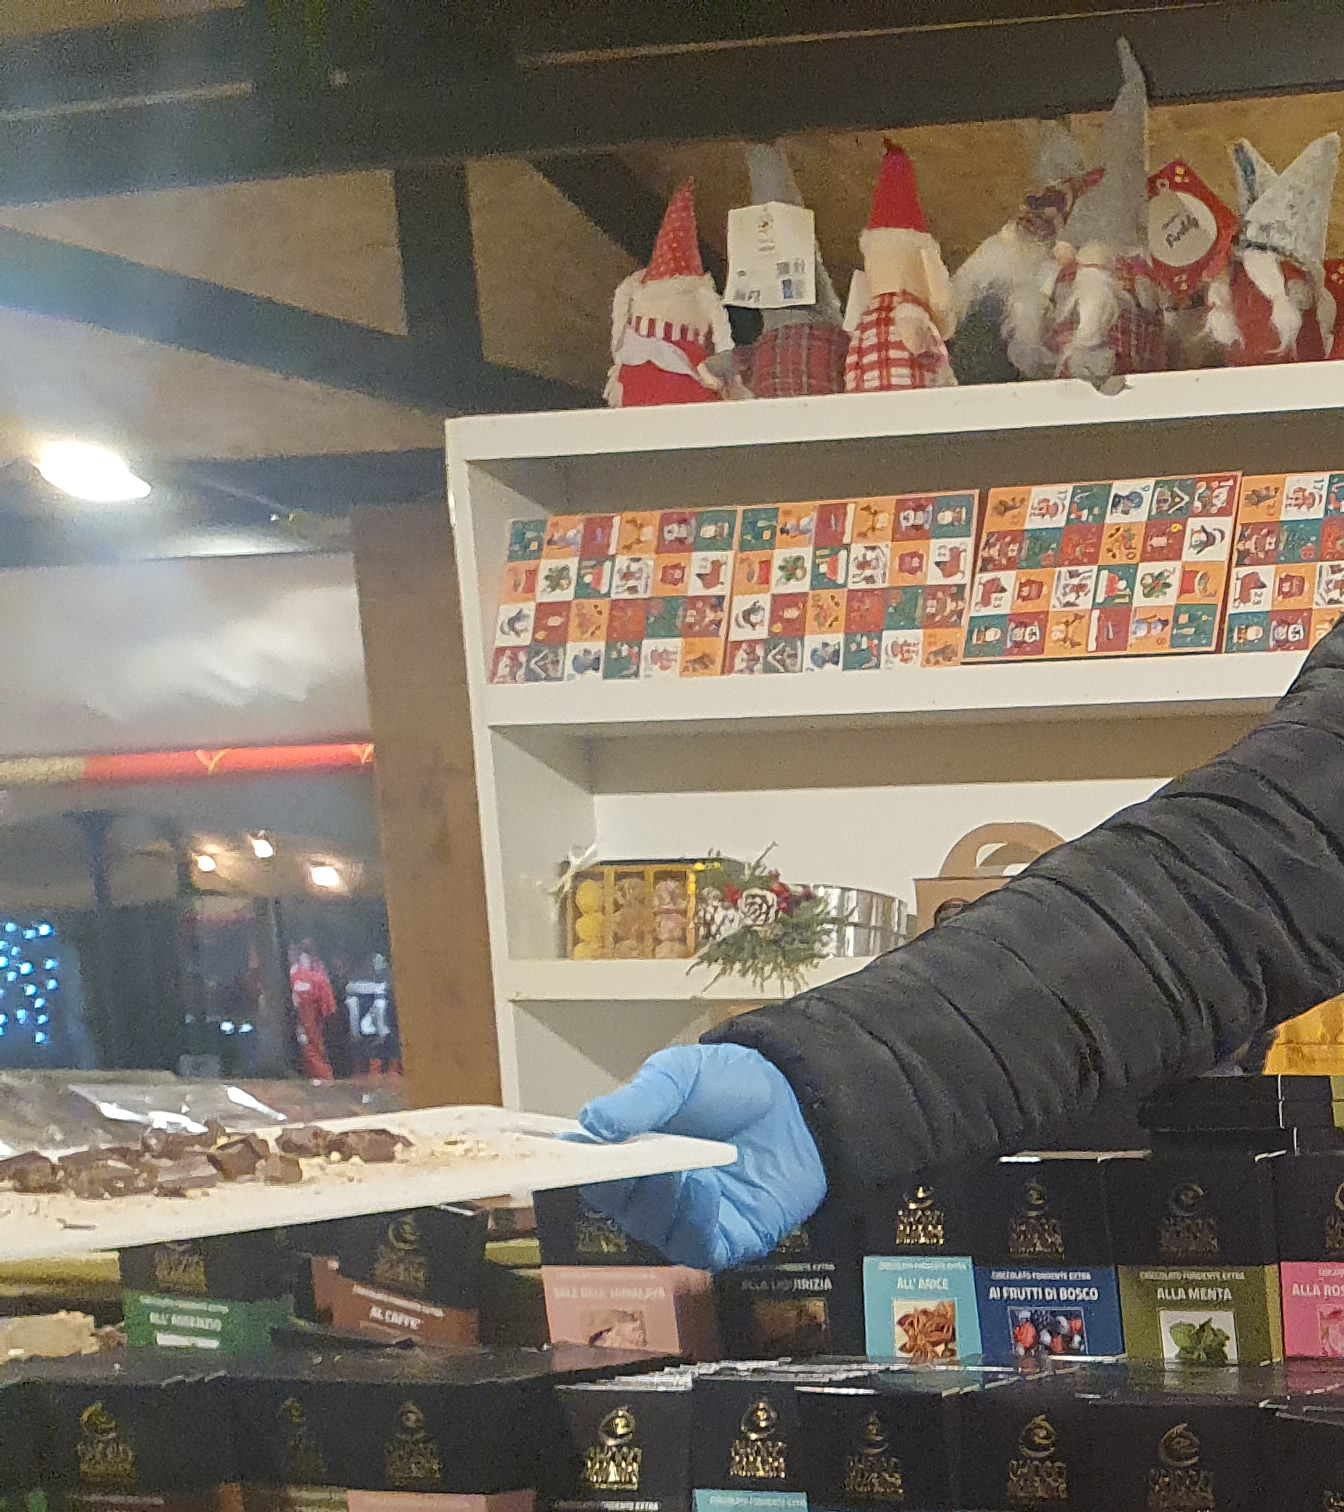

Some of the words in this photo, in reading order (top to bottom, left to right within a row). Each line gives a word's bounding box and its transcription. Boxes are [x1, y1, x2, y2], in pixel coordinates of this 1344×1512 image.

[990, 1287, 1000, 1299] AI
[1003, 1287, 1042, 1299] FRUTTI
[1045, 1288, 1057, 1299] DI
[1060, 1287, 1098, 1301] BOSCO
